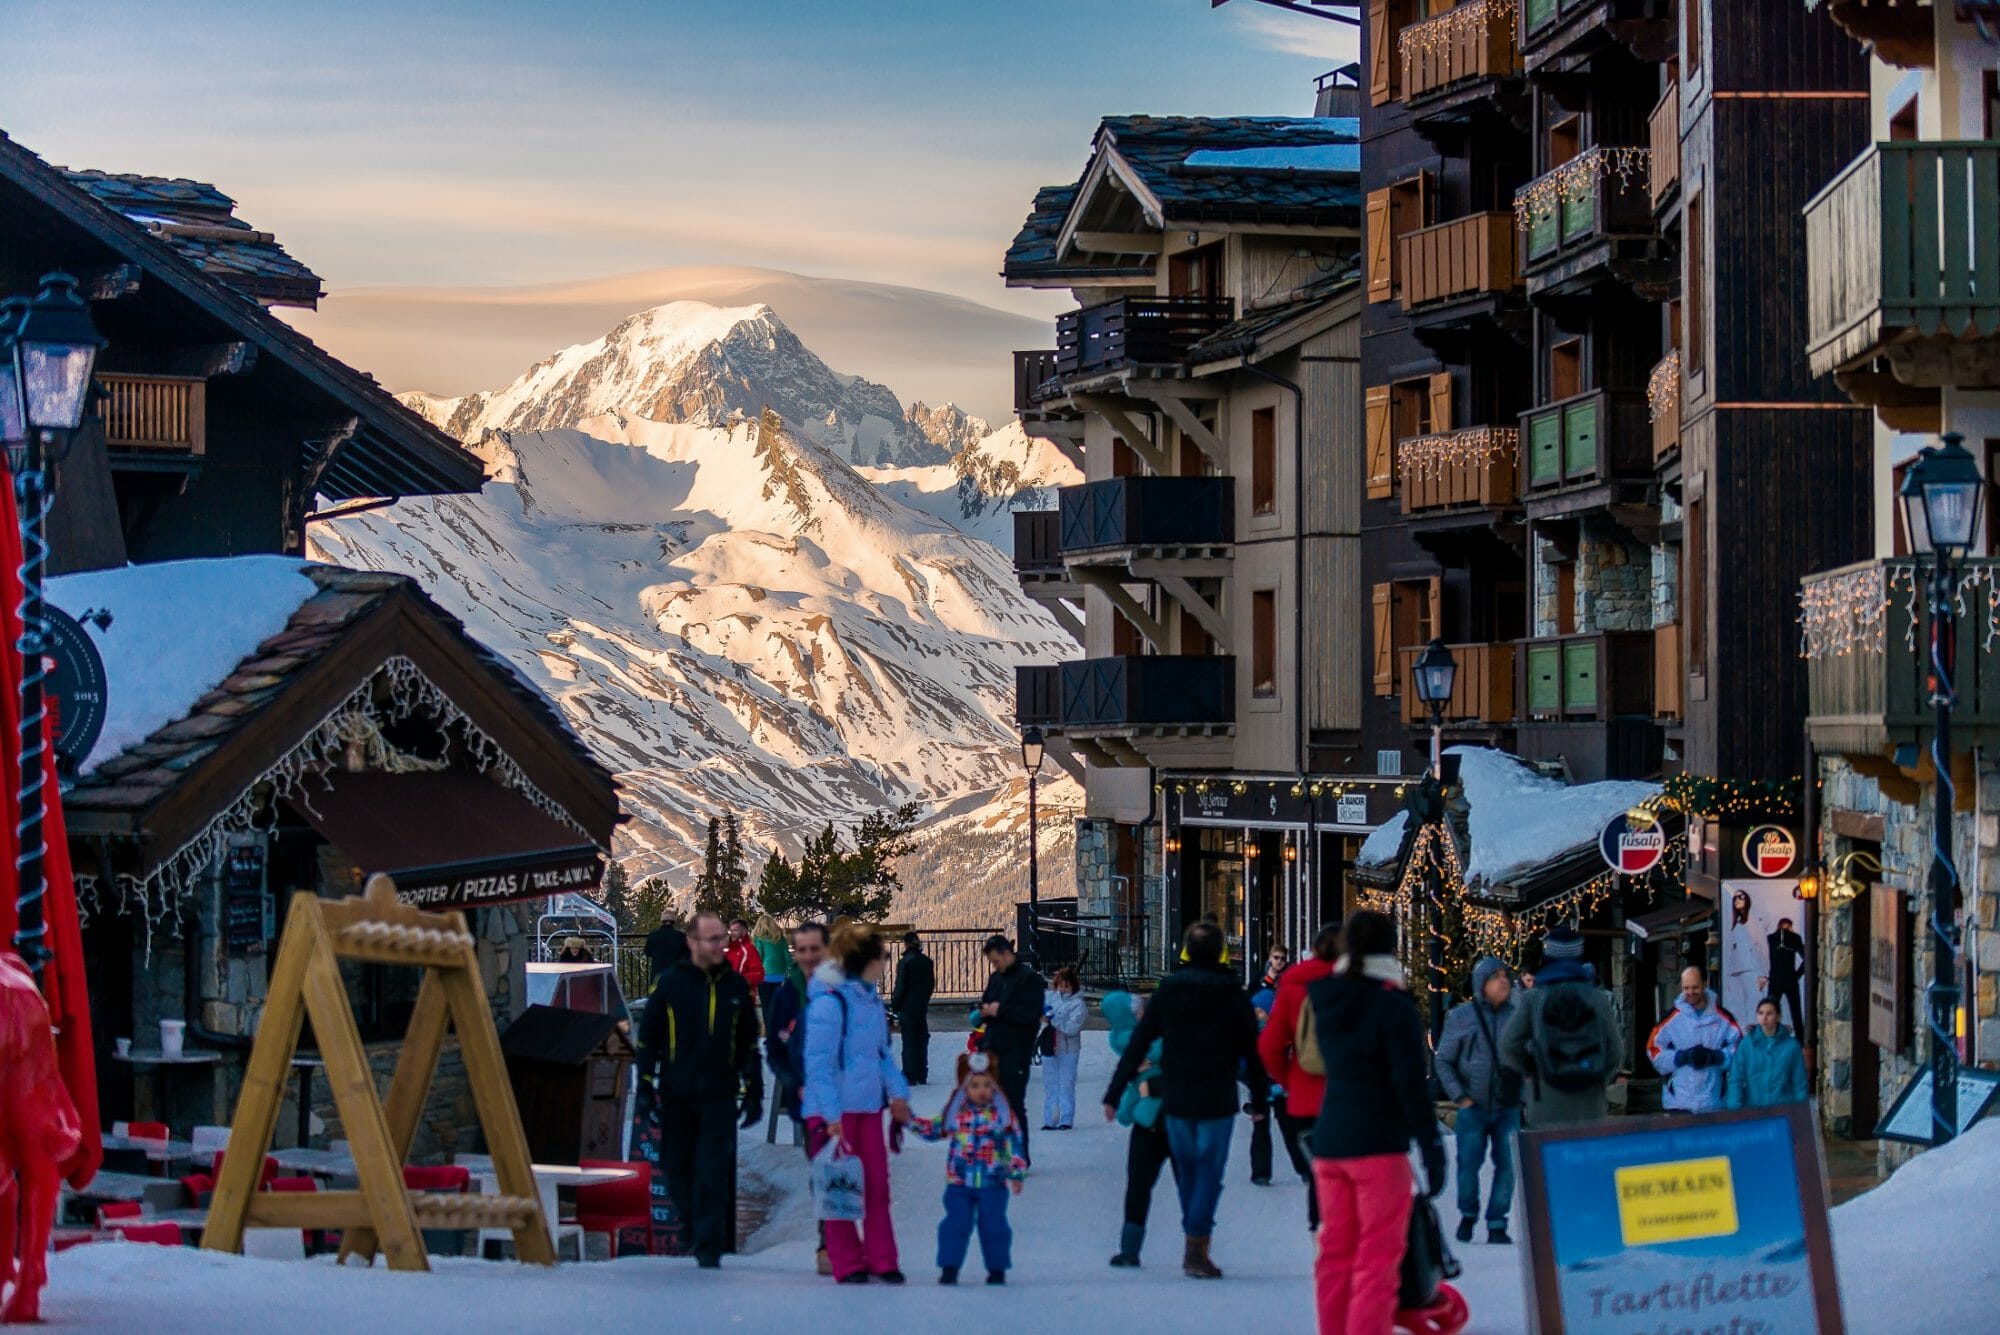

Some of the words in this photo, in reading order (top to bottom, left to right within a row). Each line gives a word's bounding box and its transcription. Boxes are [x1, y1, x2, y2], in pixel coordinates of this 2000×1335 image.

[1621, 833, 1660, 850] fusalp
[1760, 845, 1792, 858] fusalp
[463, 874, 517, 902] PIZZAS
[1621, 1174, 1725, 1199] DEMAIN
[1586, 1268, 1801, 1318] Tartiflette
